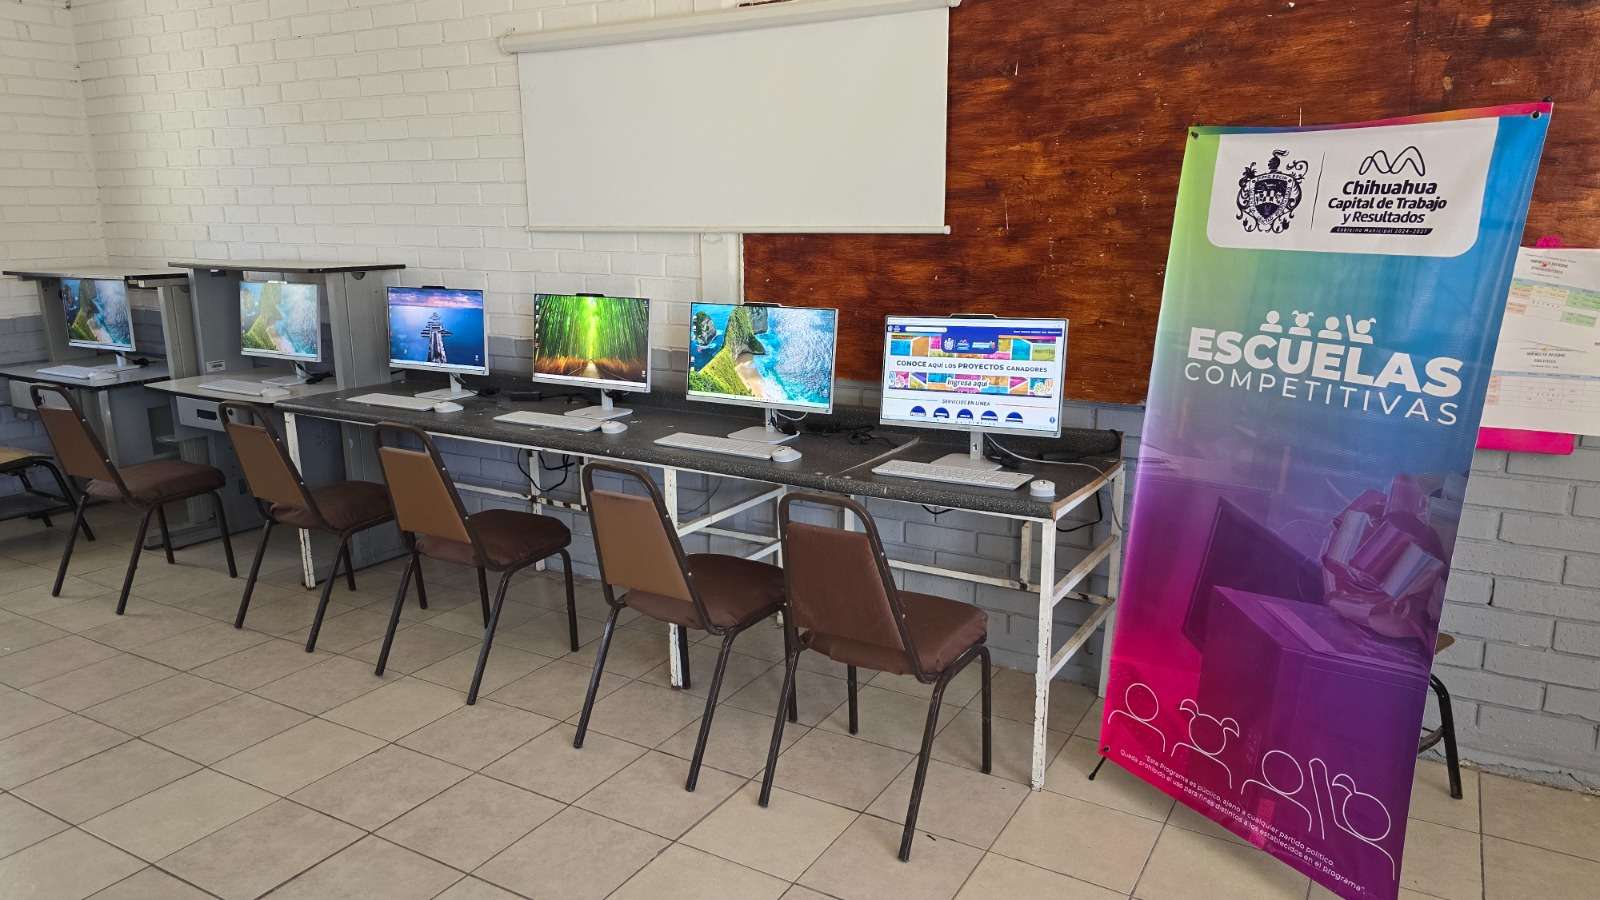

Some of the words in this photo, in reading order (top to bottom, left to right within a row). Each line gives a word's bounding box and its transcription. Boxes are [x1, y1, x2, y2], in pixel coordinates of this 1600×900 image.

[1328, 197, 1375, 211] Capital
[1376, 197, 1394, 209] de
[1396, 196, 1448, 212] Trabajo
[1342, 179, 1438, 195] Chihuahua
[1341, 212, 1351, 225] y
[1352, 211, 1426, 223] Resultados
[896, 360, 927, 368] CONOCE
[957, 362, 1005, 371] PROYECTOS
[1187, 327, 1464, 398] ESCUELAS
[1184, 362, 1459, 425] COMPETITIVAS
[1120, 749, 1138, 763] Queda
[1172, 780, 1184, 789] uso
[1184, 786, 1198, 798] para
[1199, 793, 1215, 807] fines
[1215, 803, 1243, 823] distintos
[1249, 821, 1259, 832] los
[1259, 829, 1303, 858] establecidos
[1303, 854, 1313, 864] en
[1314, 860, 1322, 869] el
[1189, 780, 1197, 788] es
[1222, 799, 1241, 812] ajeno
[1247, 813, 1279, 834] cualquier
[1279, 831, 1305, 849] partido
